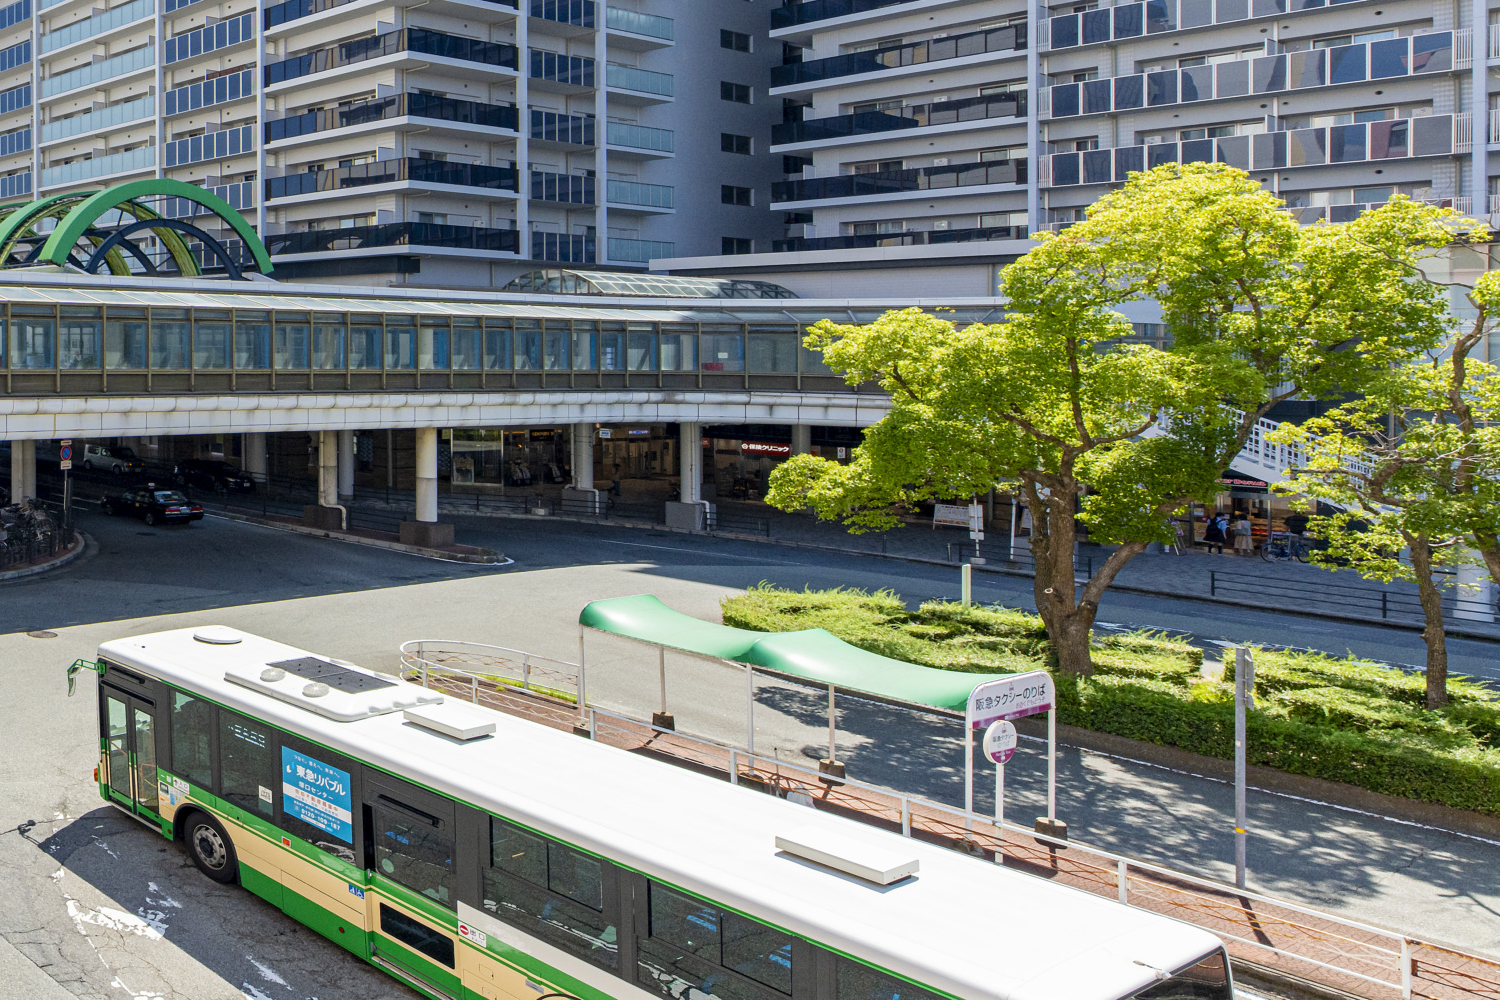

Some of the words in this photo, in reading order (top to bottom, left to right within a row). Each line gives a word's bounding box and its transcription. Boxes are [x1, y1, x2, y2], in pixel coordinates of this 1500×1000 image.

[975, 683, 1047, 712] 阪急タクシーのりば
[296, 764, 346, 796] 東急リバブル
